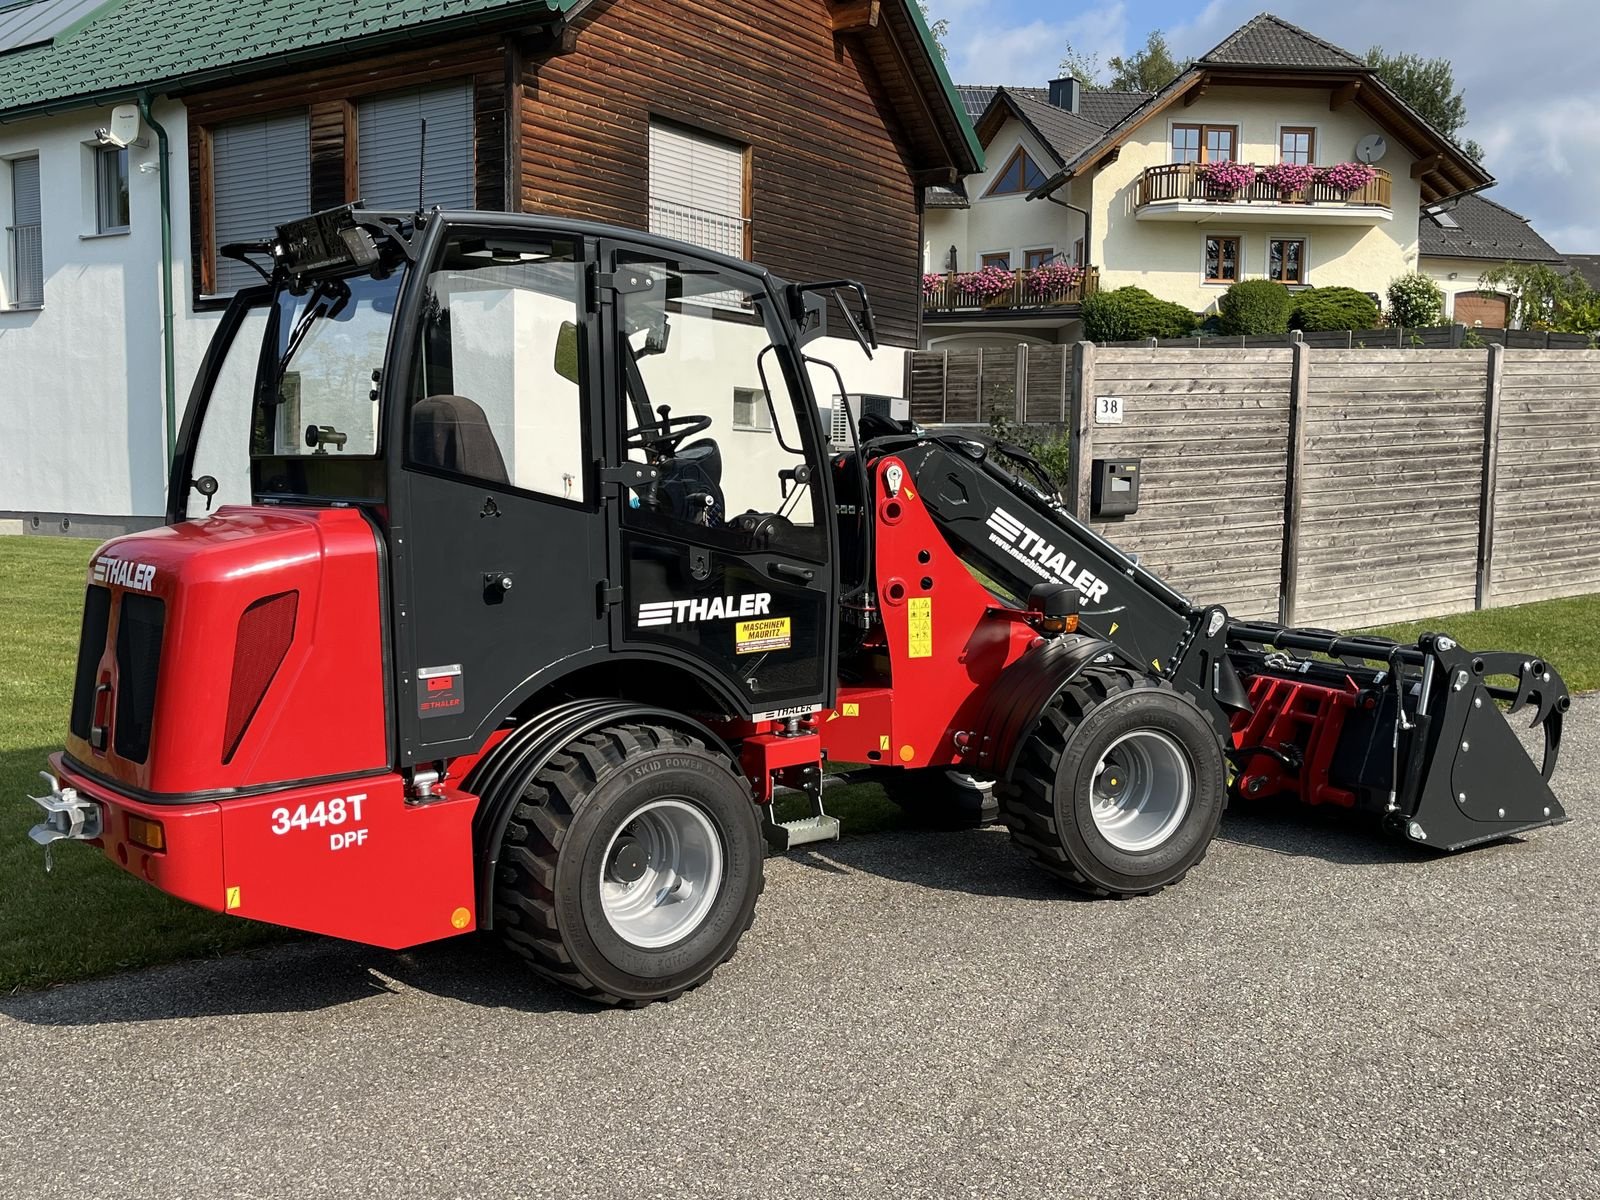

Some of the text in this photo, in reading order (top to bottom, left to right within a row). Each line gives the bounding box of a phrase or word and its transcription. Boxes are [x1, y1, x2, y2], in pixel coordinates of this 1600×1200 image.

[1101, 399, 1118, 414] 38
[1019, 526, 1109, 604] THALER
[105, 558, 157, 593] THALER
[673, 592, 772, 624] THALER
[742, 619, 786, 633] MASCHINEN
[747, 629, 781, 641] MAURITZ
[431, 698, 461, 710] THALER
[634, 759, 662, 777] SKID
[271, 793, 368, 835] 3448T
[330, 828, 369, 851] DPF
